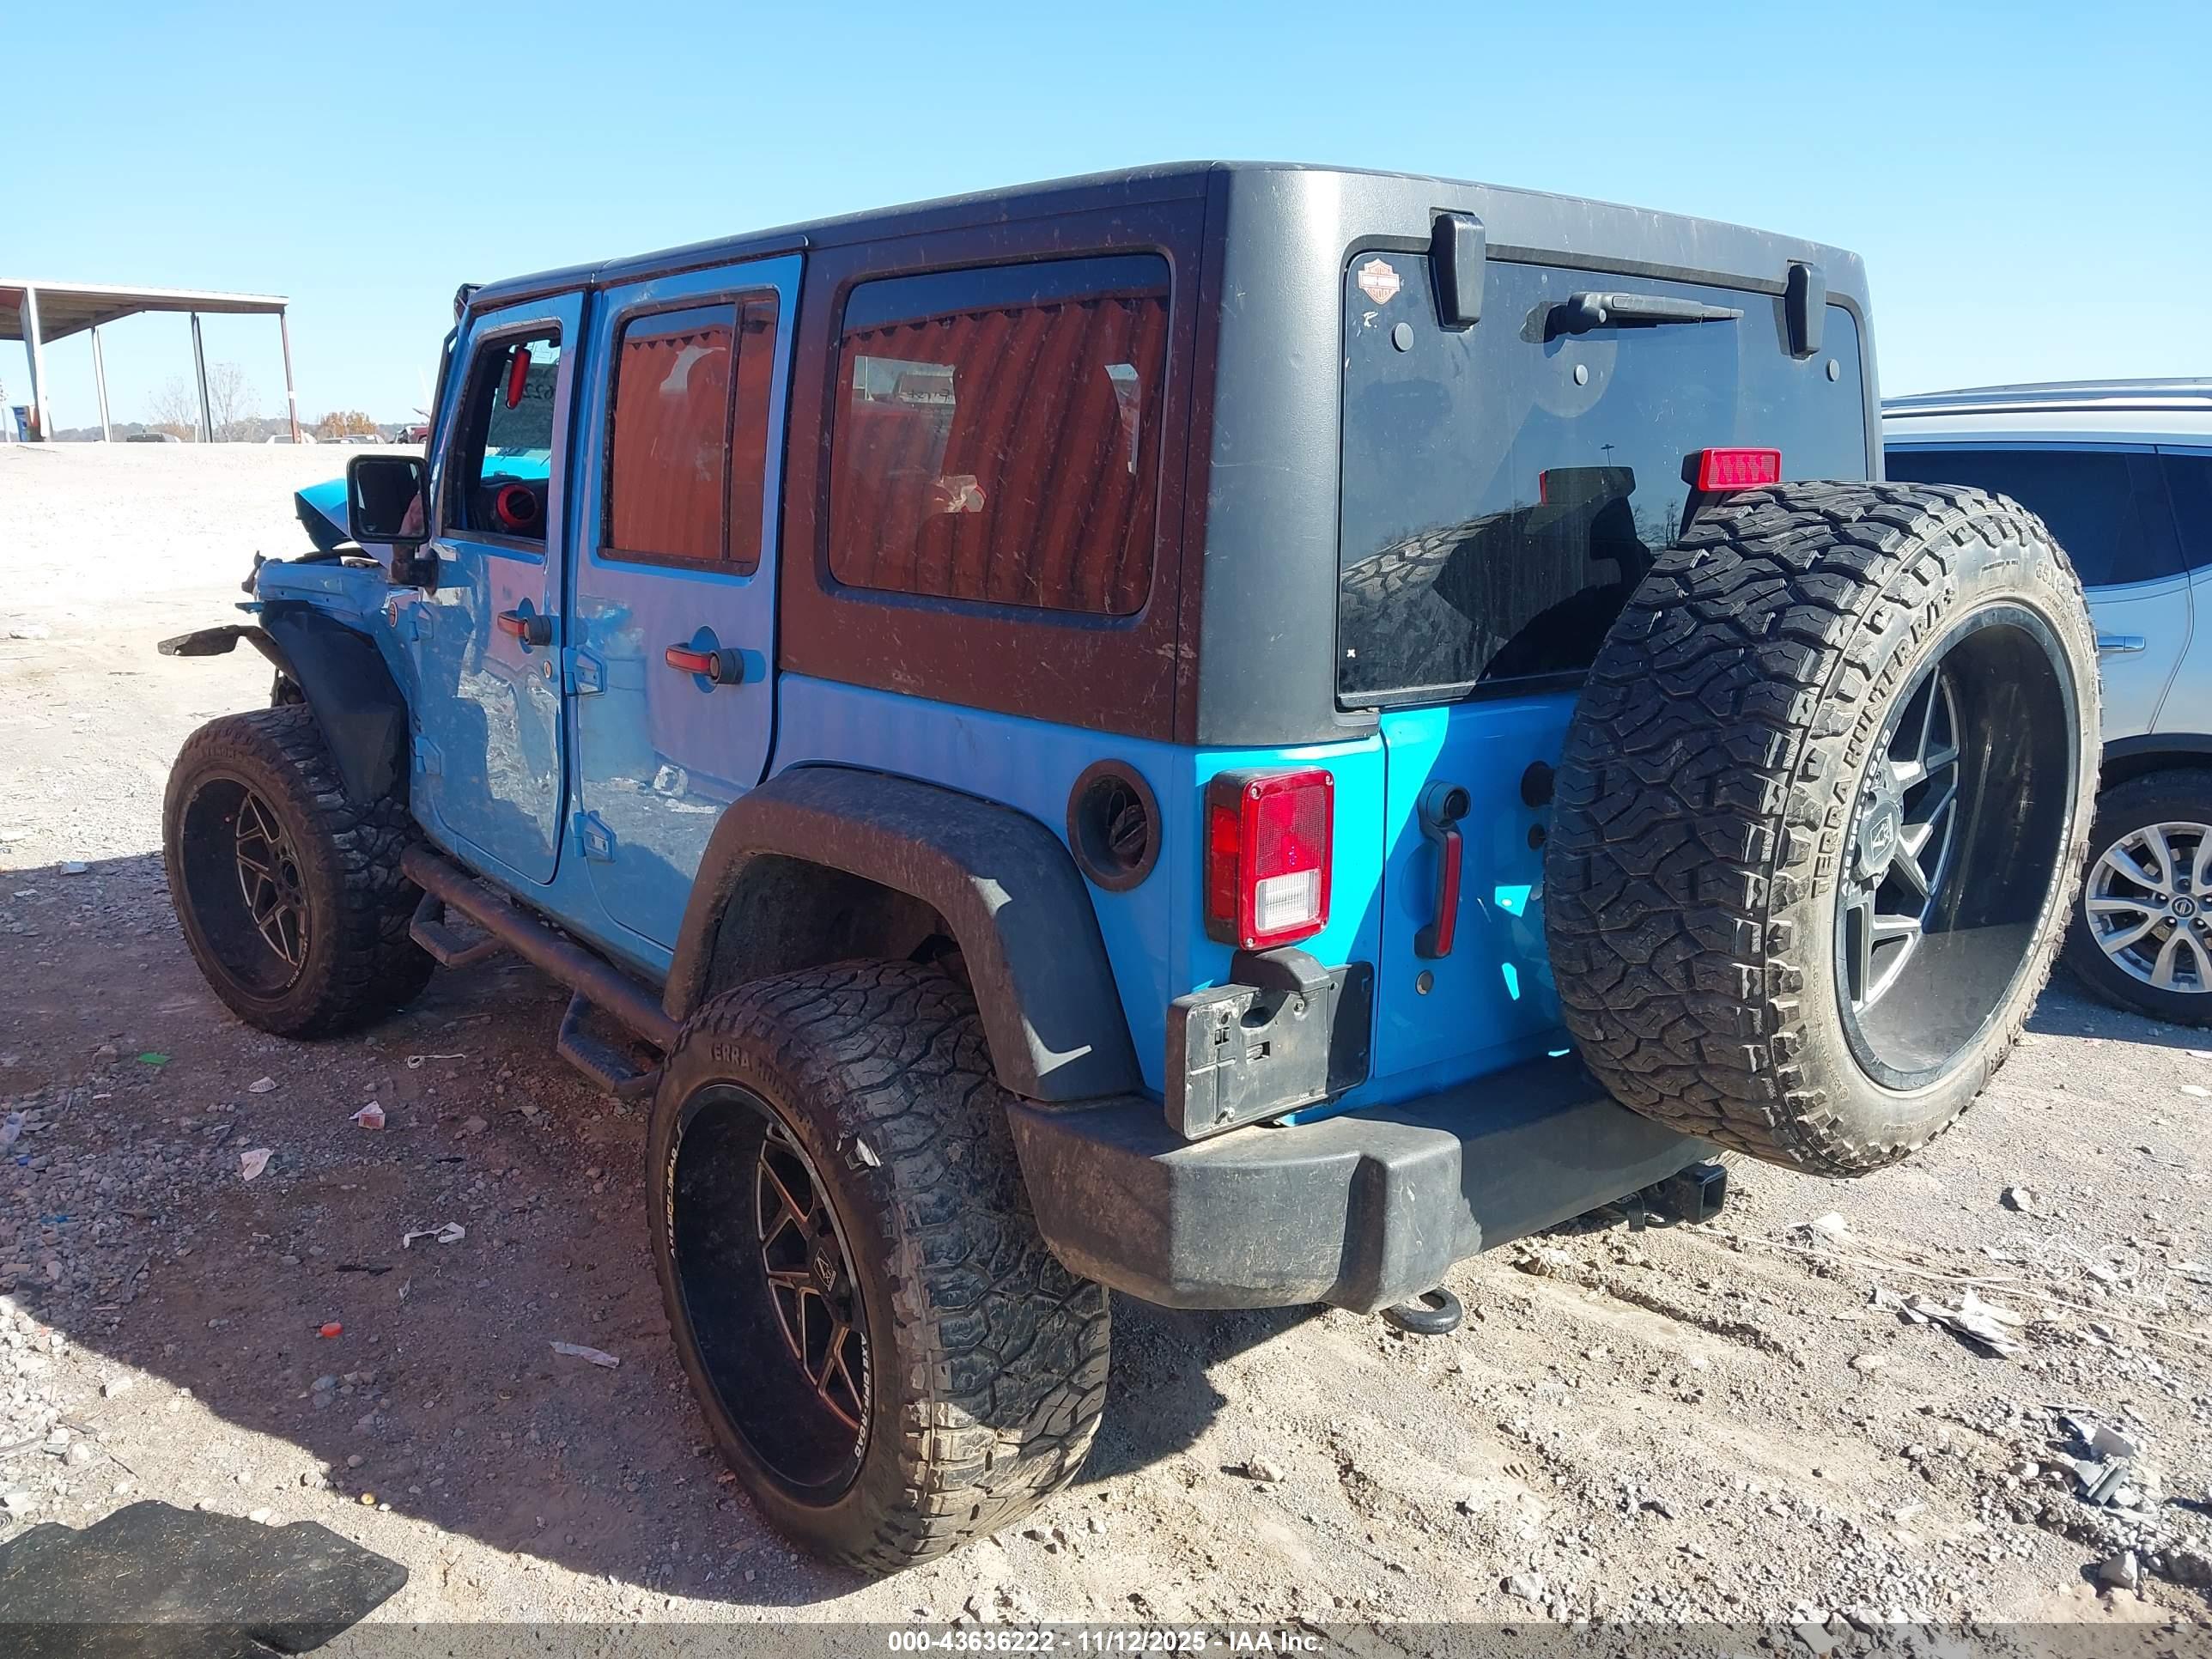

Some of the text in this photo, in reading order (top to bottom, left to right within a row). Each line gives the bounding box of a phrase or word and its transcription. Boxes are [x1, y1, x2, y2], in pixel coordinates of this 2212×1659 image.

[1812, 776, 1852, 898] TERRA
[1844, 638, 1911, 769] HUNTER
[1840, 729, 1891, 896] AXE OFF-ROAD
[854, 1373, 872, 1459] OFF-ROAD
